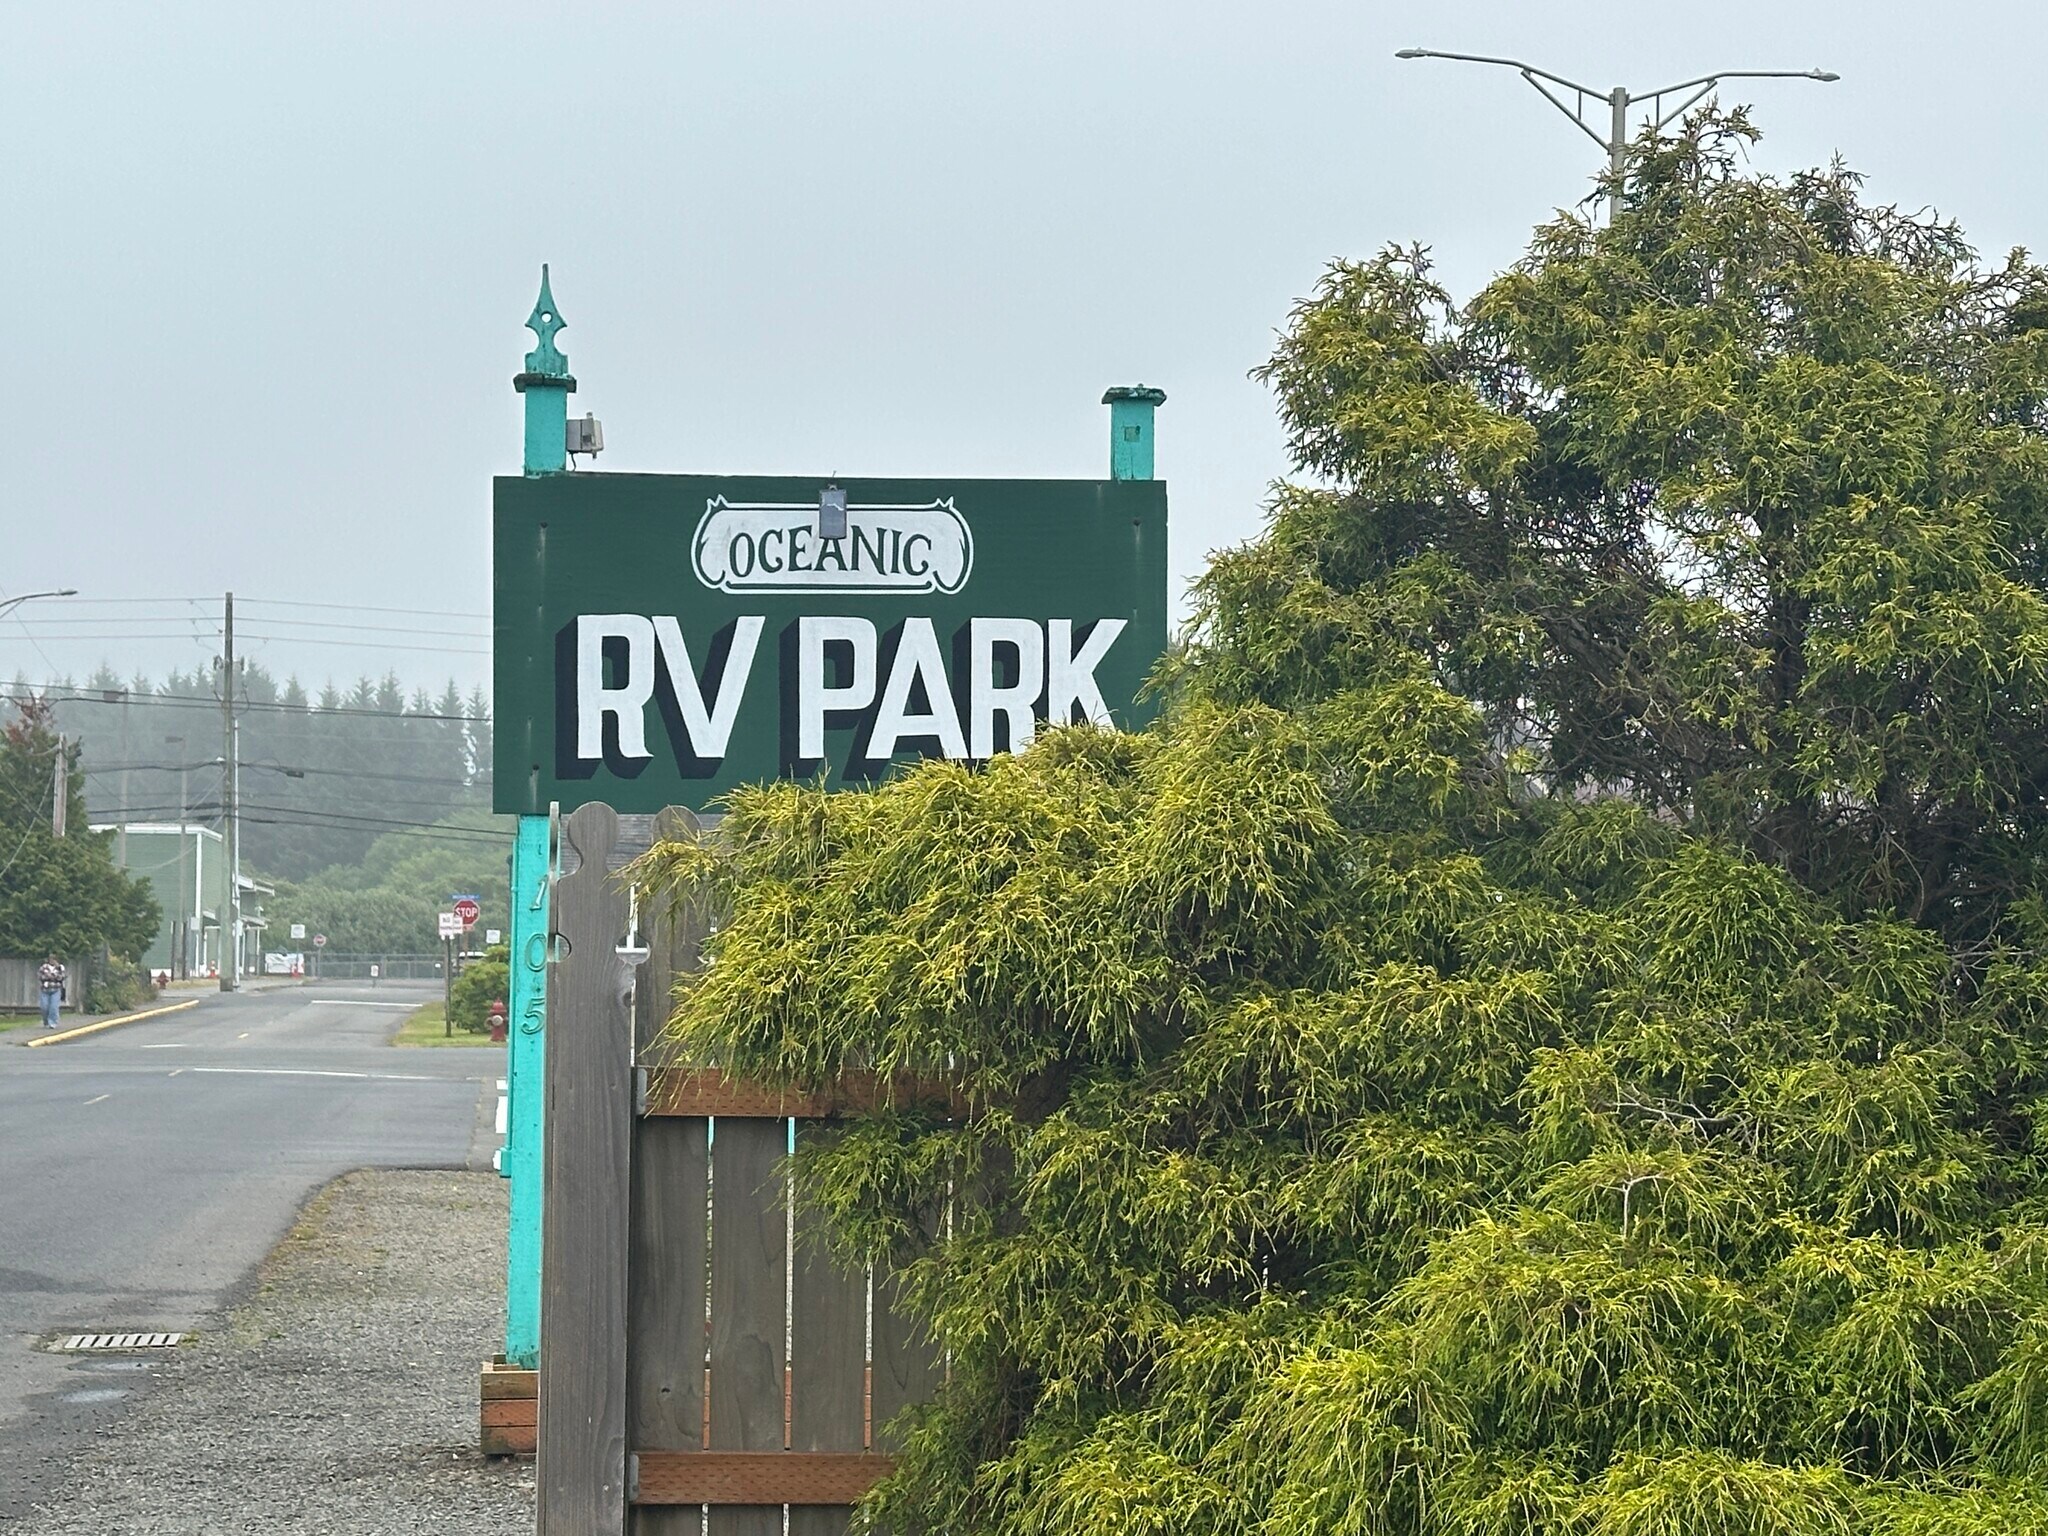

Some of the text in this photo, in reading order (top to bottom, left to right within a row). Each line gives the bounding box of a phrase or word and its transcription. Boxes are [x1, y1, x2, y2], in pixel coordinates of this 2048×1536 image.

[729, 525, 932, 578] OCEANIC
[577, 614, 1128, 759] RV PARK
[455, 907, 478, 918] STOP
